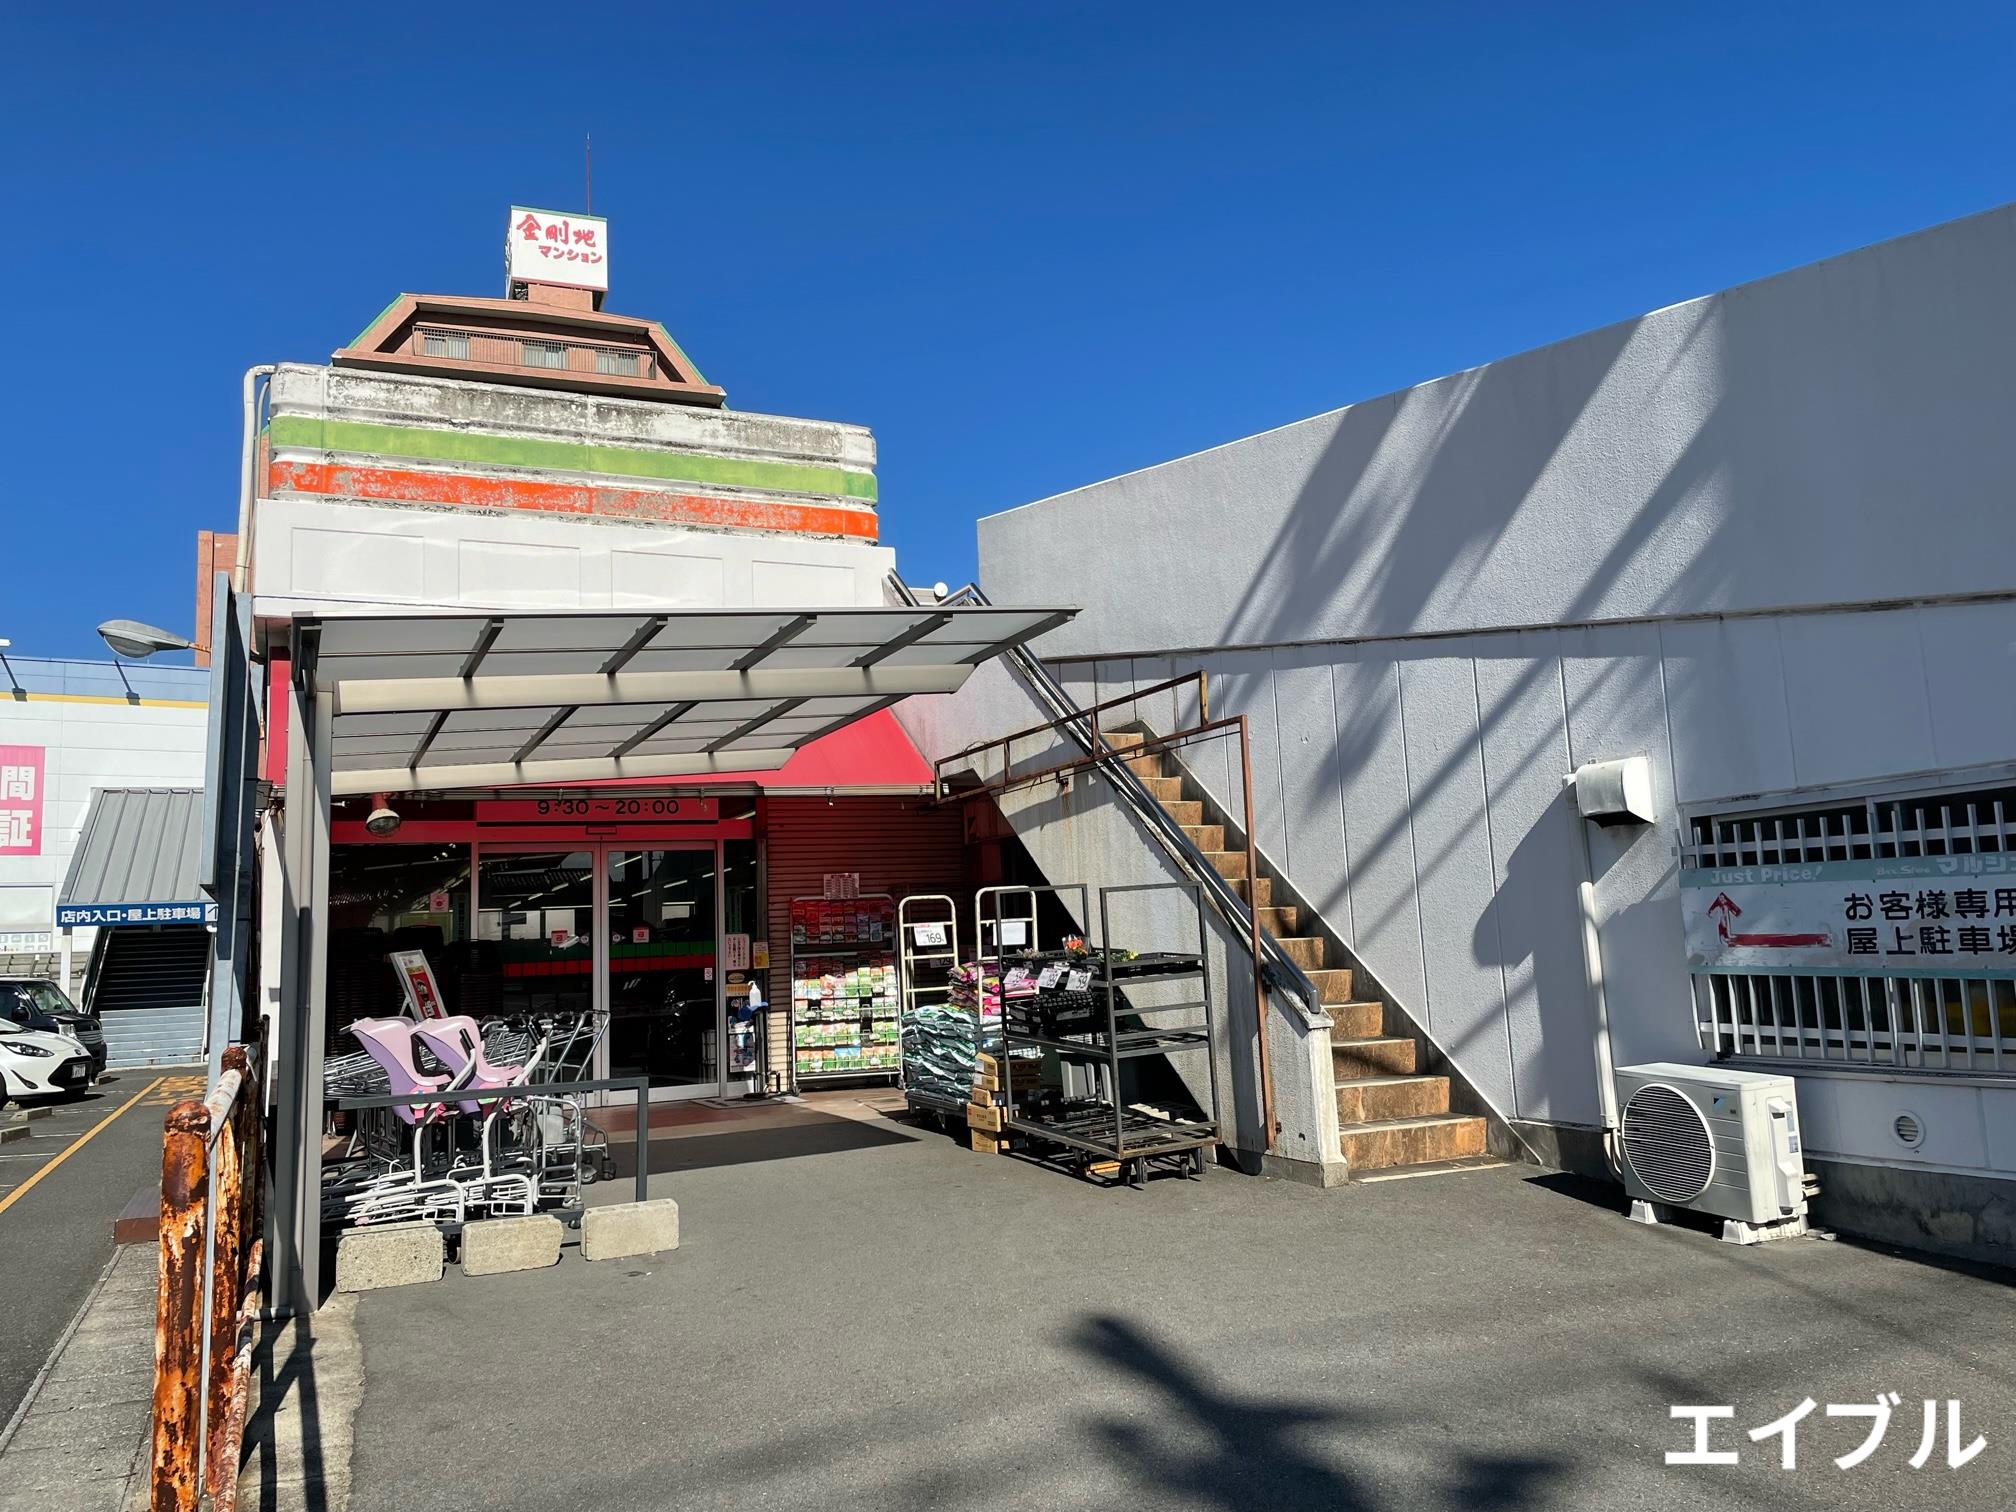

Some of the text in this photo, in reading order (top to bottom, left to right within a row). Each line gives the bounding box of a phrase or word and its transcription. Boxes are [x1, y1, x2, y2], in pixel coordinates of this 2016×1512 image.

[516, 213, 597, 247] 金剛地
[538, 245, 603, 263] マンション
[0, 766, 36, 800] 間
[1711, 865, 1824, 885] Just Price!
[1844, 888, 2016, 921] お客様専用
